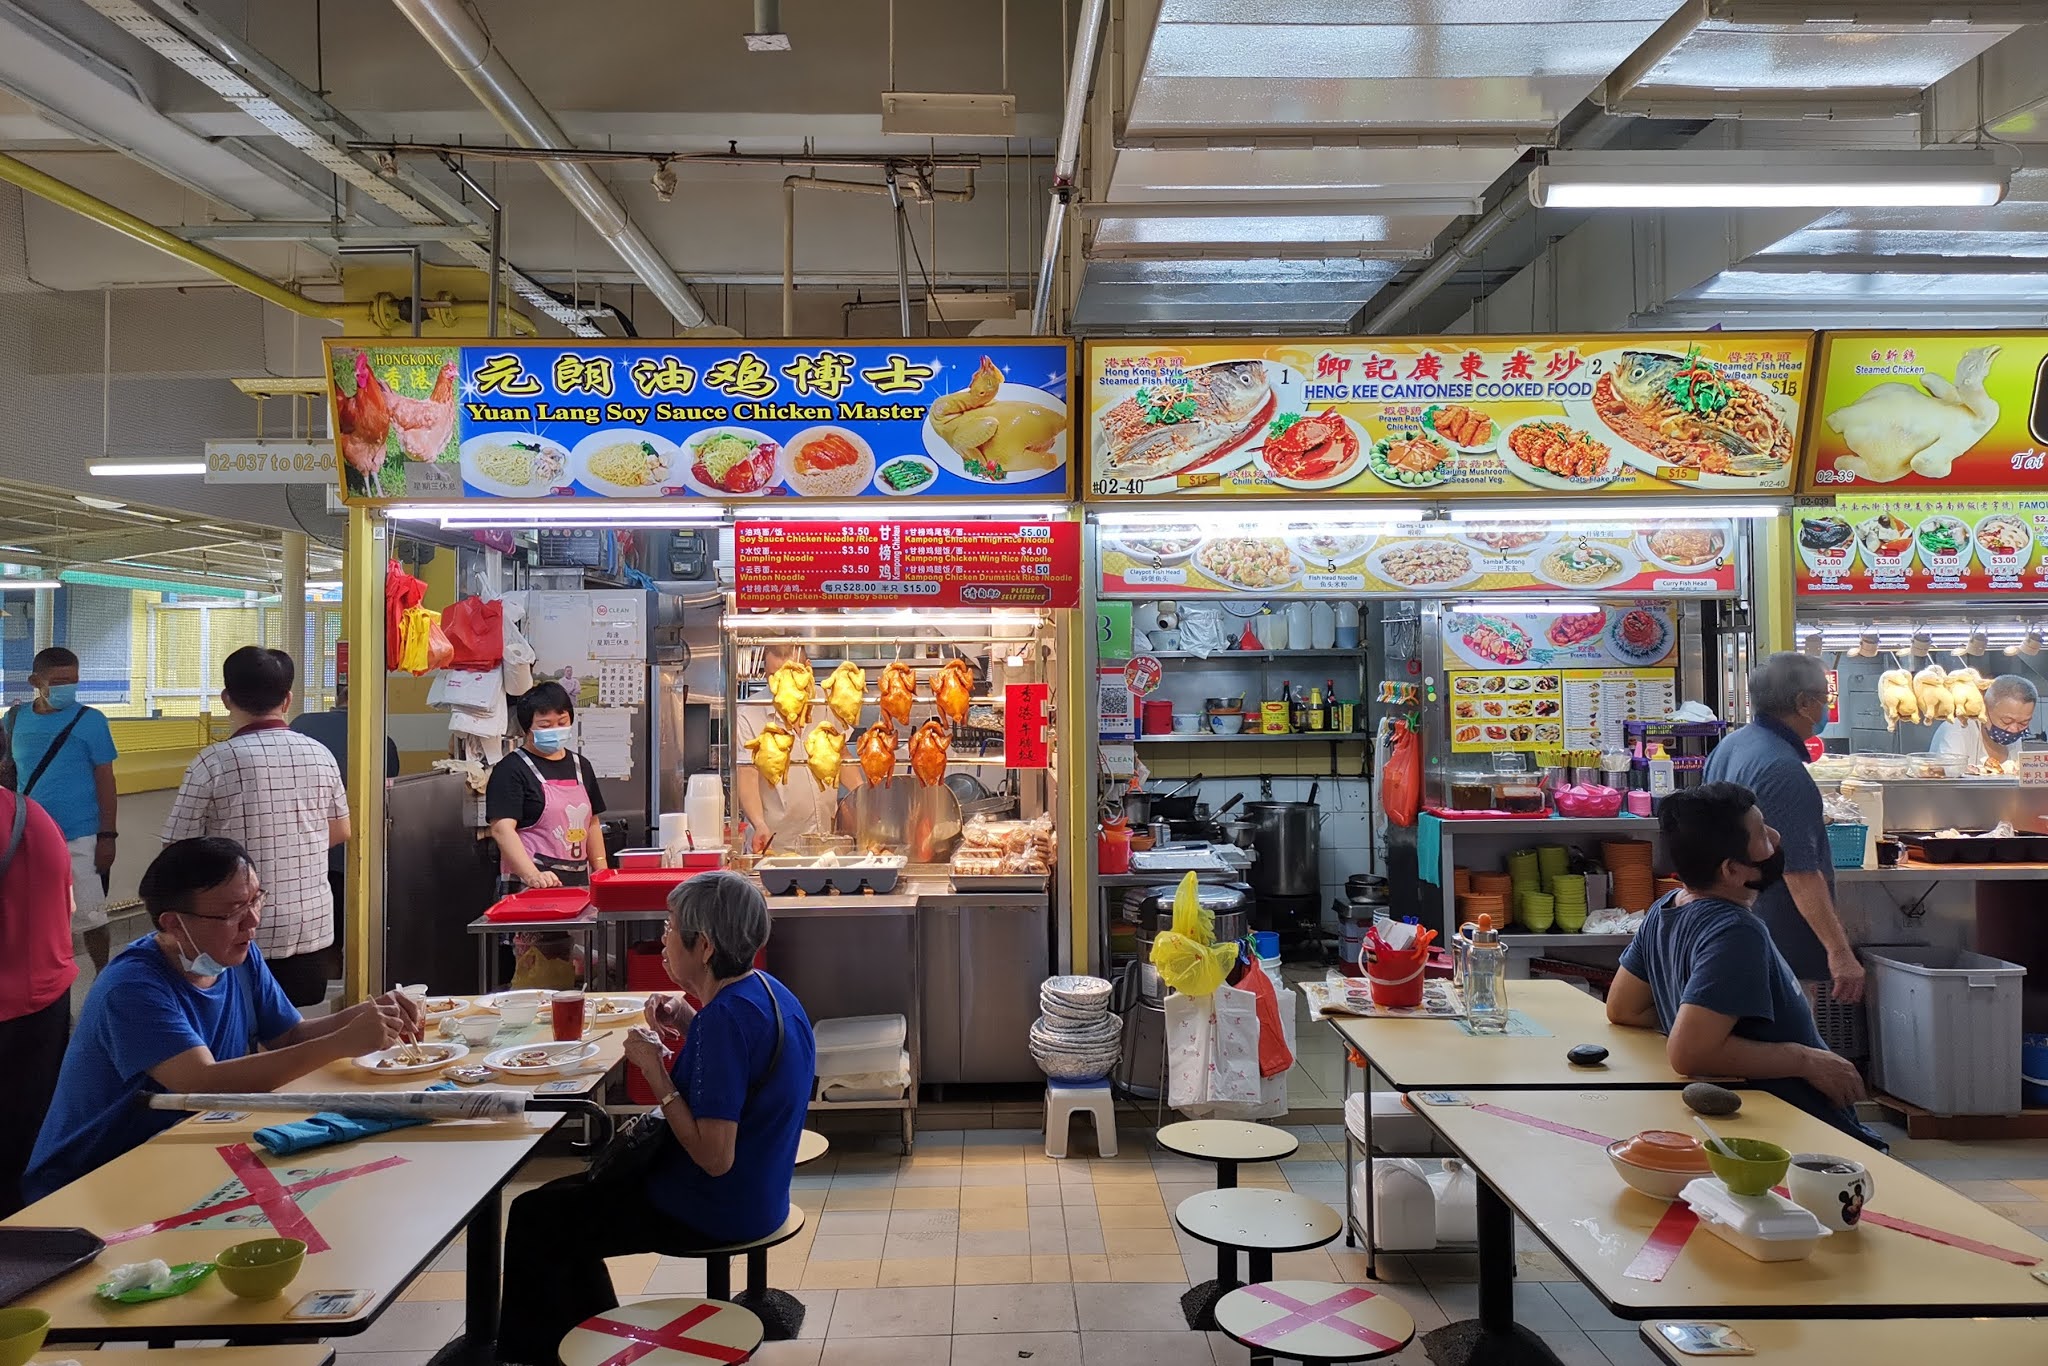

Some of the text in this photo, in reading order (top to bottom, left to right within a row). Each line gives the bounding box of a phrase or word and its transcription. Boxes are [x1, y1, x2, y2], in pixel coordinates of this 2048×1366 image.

[376, 354, 443, 365] HONGKONG
[1317, 351, 1585, 383] 卿記廣東煮炒
[1592, 359, 1602, 375] 2
[1713, 362, 1802, 371] Steamed Fish Head
[1856, 365, 1925, 374] Steamed Chicken
[476, 351, 934, 397] 元朗油鸡博士
[1105, 368, 1183, 377] Hong Kong Style
[1281, 369, 1290, 385] 1
[1724, 371, 1789, 380] w/Bean Sauce
[384, 367, 432, 391] 香港
[1099, 377, 1188, 385] Steamed Fish Head
[1305, 382, 1592, 399] HENG KEE CANTONESE COOKED FOOD
[467, 402, 926, 425] Yuan Lang Soy Sauce Chicken Master
[1379, 415, 1427, 423] Prawn Paste
[1386, 423, 1418, 431] Chicken
[209, 453, 339, 472] 02-037 to 02-04
[2011, 449, 2045, 471] Tai
[1668, 468, 1688, 479] $15
[1816, 470, 1855, 483] 02-39
[1189, 475, 1208, 485] $15
[1759, 480, 1785, 488] #02-40
[1093, 479, 1144, 494] #02-40
[1800, 498, 1829, 506] 02-039
[842, 527, 870, 536] $3.50
[1021, 528, 1048, 537] $5.00
[739, 535, 757, 543] Soy
[758, 535, 784, 543] Sauce
[786, 535, 822, 543] Chicken
[824, 535, 854, 543] Noodle
[905, 536, 943, 544] Kampong
[842, 546, 870, 555] $3.50
[892, 525, 902, 581] Kampong Chicken
[1020, 547, 1048, 556] $4.00
[740, 555, 782, 563] Dumpling
[905, 555, 943, 563] Kampong
[979, 555, 1000, 563] Wing
[1816, 558, 1841, 566] $4.00
[1876, 558, 1900, 566] $3.00
[1992, 556, 2017, 564] $3.00
[842, 565, 870, 574] $3.50
[1020, 566, 1049, 575] $6.50
[1327, 559, 1337, 573] 5
[905, 574, 943, 582] Kampong
[903, 584, 937, 593] $15.00
[1663, 580, 1679, 588] Curry
[740, 593, 782, 601] Kampong
[854, 593, 869, 601] Soy
